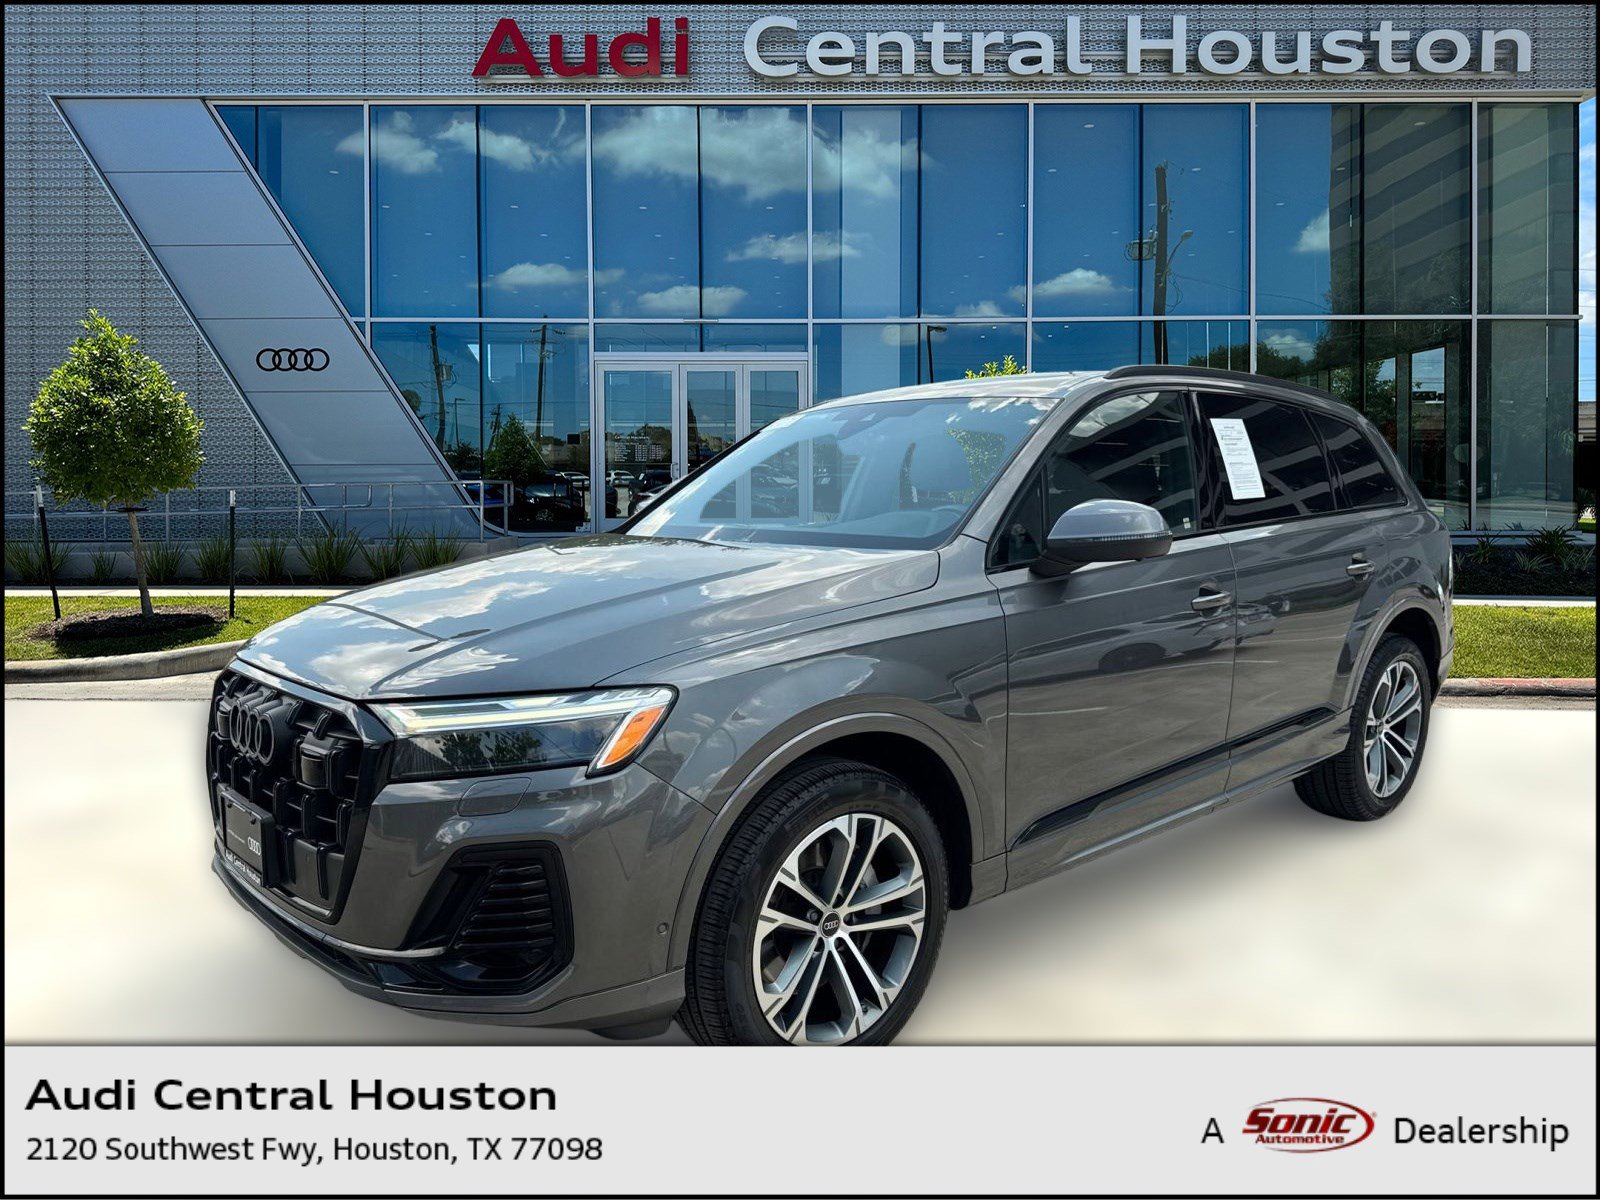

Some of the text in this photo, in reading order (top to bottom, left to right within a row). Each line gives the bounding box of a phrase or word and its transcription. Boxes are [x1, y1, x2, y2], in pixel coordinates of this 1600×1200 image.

[471, 15, 1532, 78] Audi Central Houston
